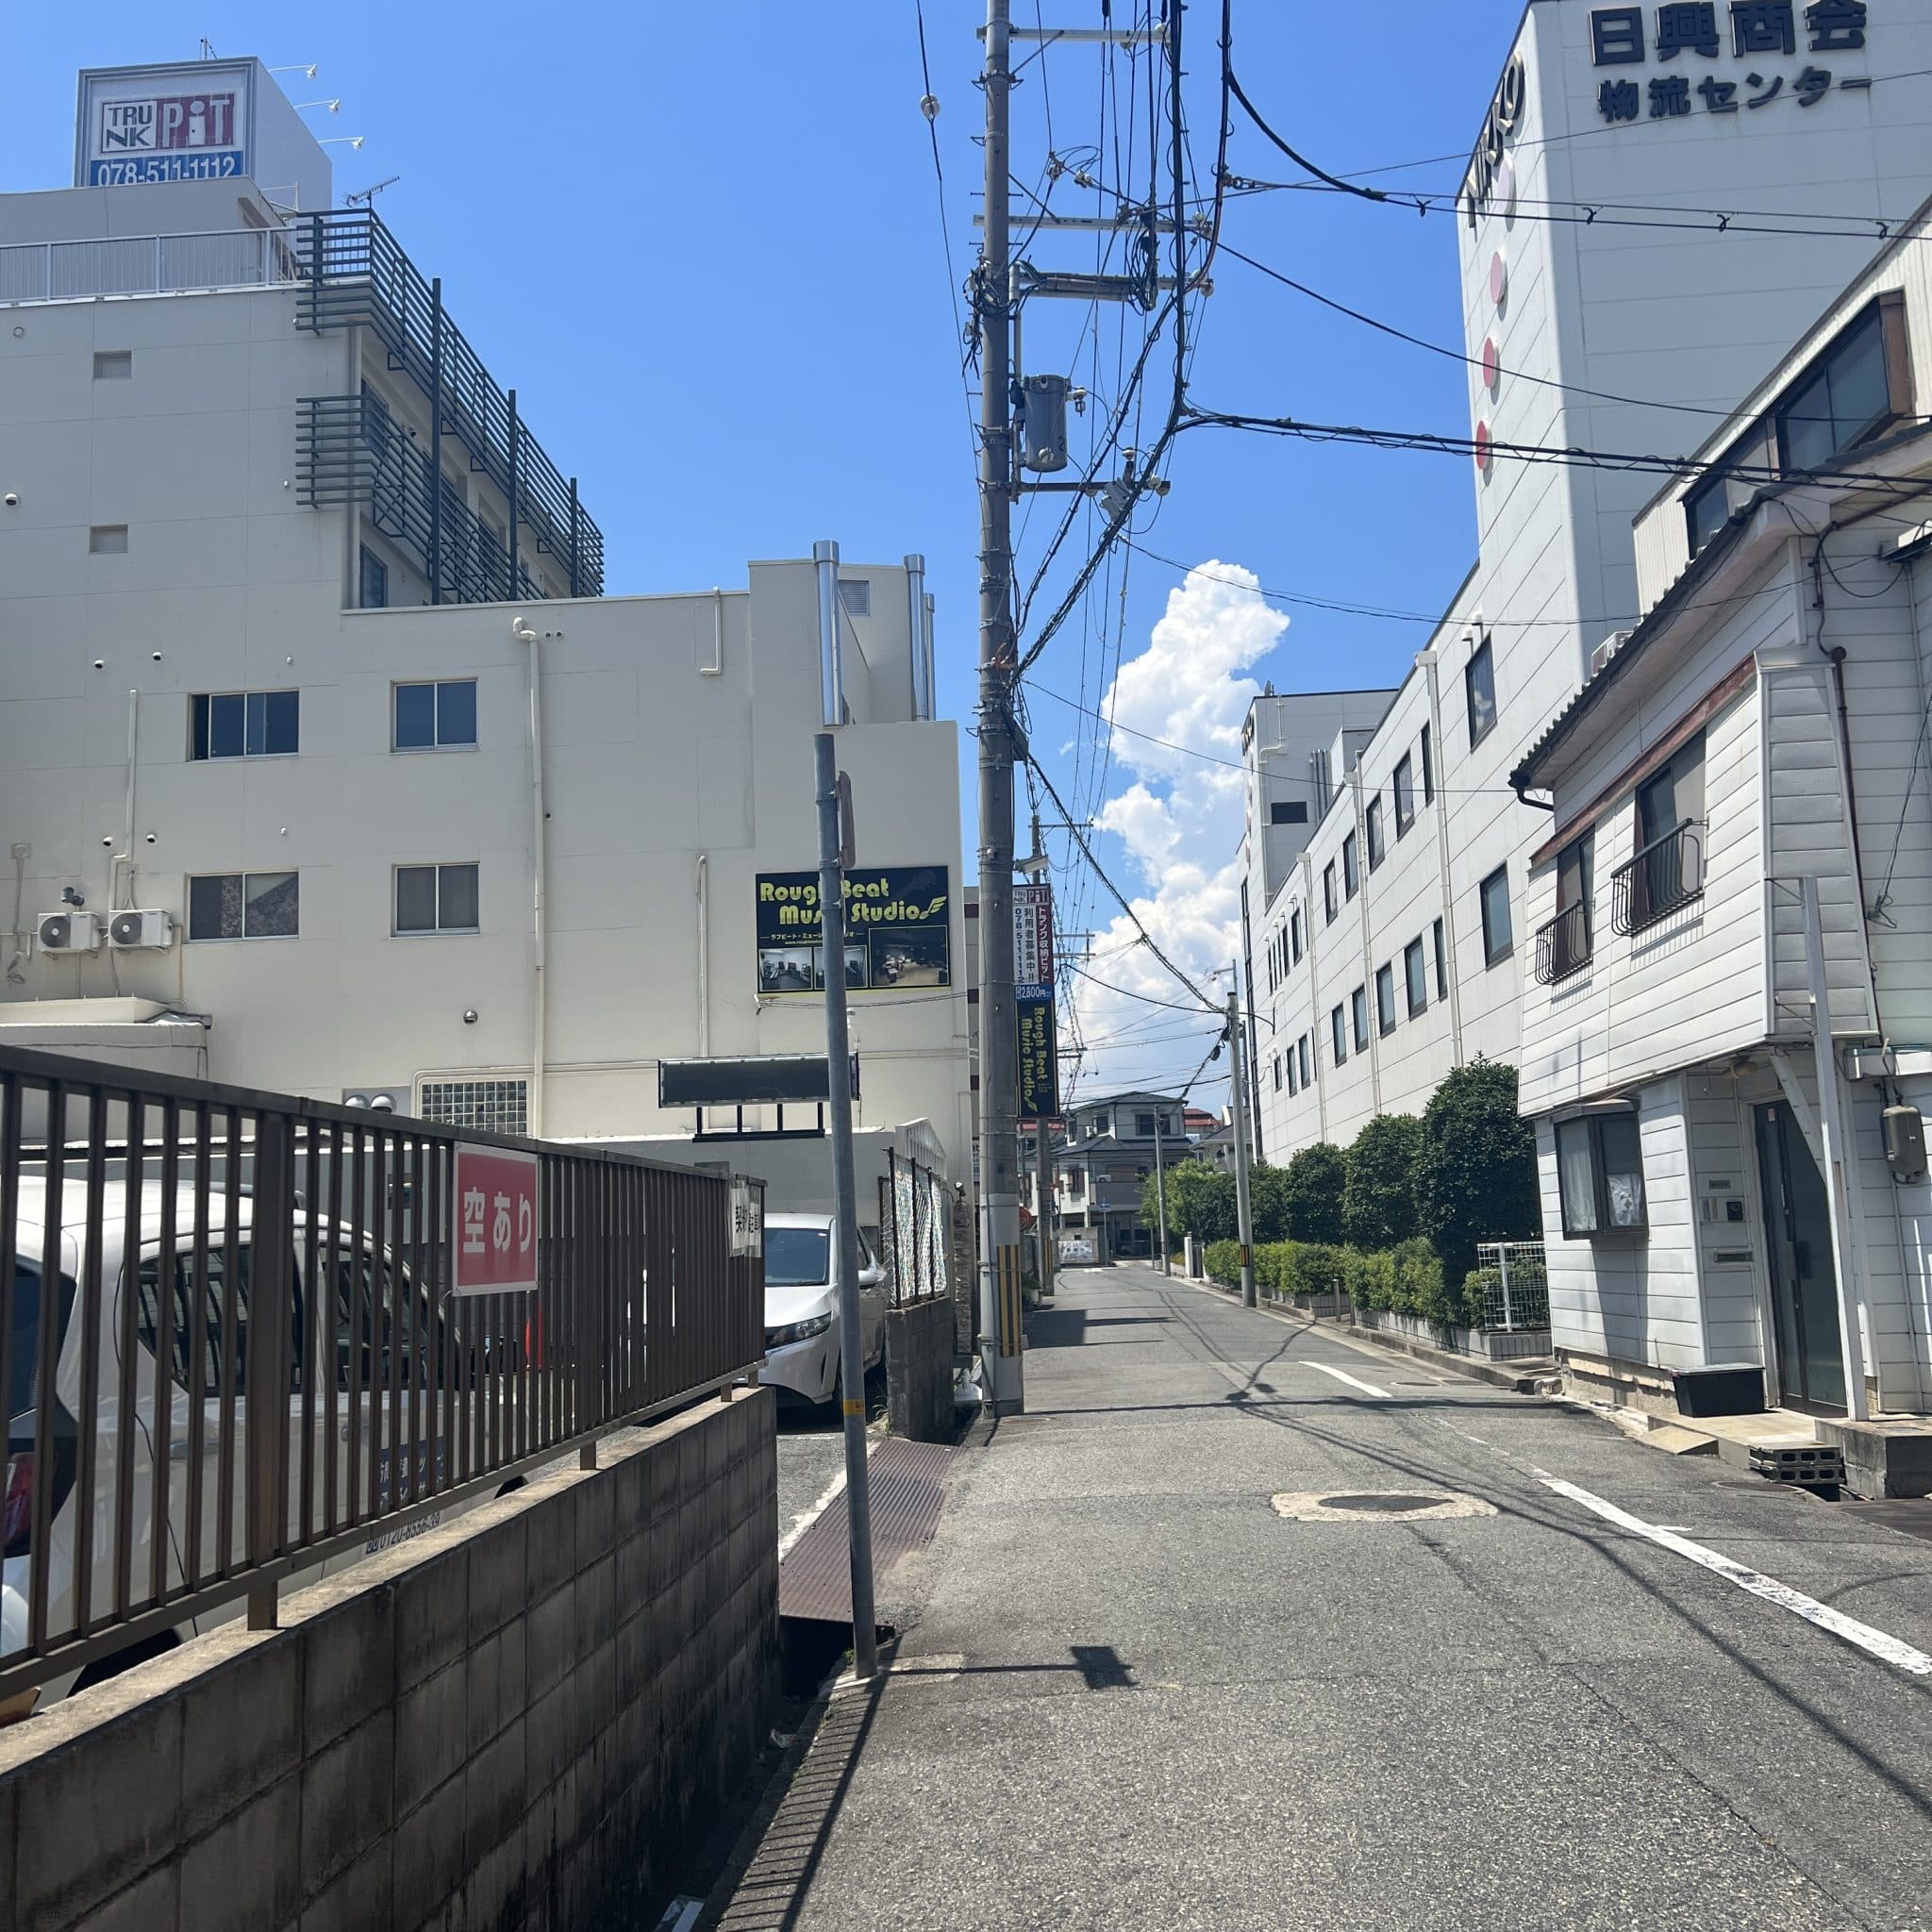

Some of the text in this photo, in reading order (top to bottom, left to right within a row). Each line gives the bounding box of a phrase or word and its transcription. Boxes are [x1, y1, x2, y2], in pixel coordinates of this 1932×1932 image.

[1590, 0, 1867, 66] 日興商会
[1597, 66, 1873, 123] 物流センター
[108, 105, 153, 127] TRU
[106, 125, 151, 148] NK
[97, 157, 235, 186] 078-511-1112
[759, 881, 822, 906] Roug
[779, 900, 921, 925] Mus Studio
[1033, 1007, 1046, 1047] Rough
[1022, 1018, 1036, 1097] Music Studio
[1037, 1050, 1048, 1080] Beat
[463, 1186, 531, 1254] 空あり
